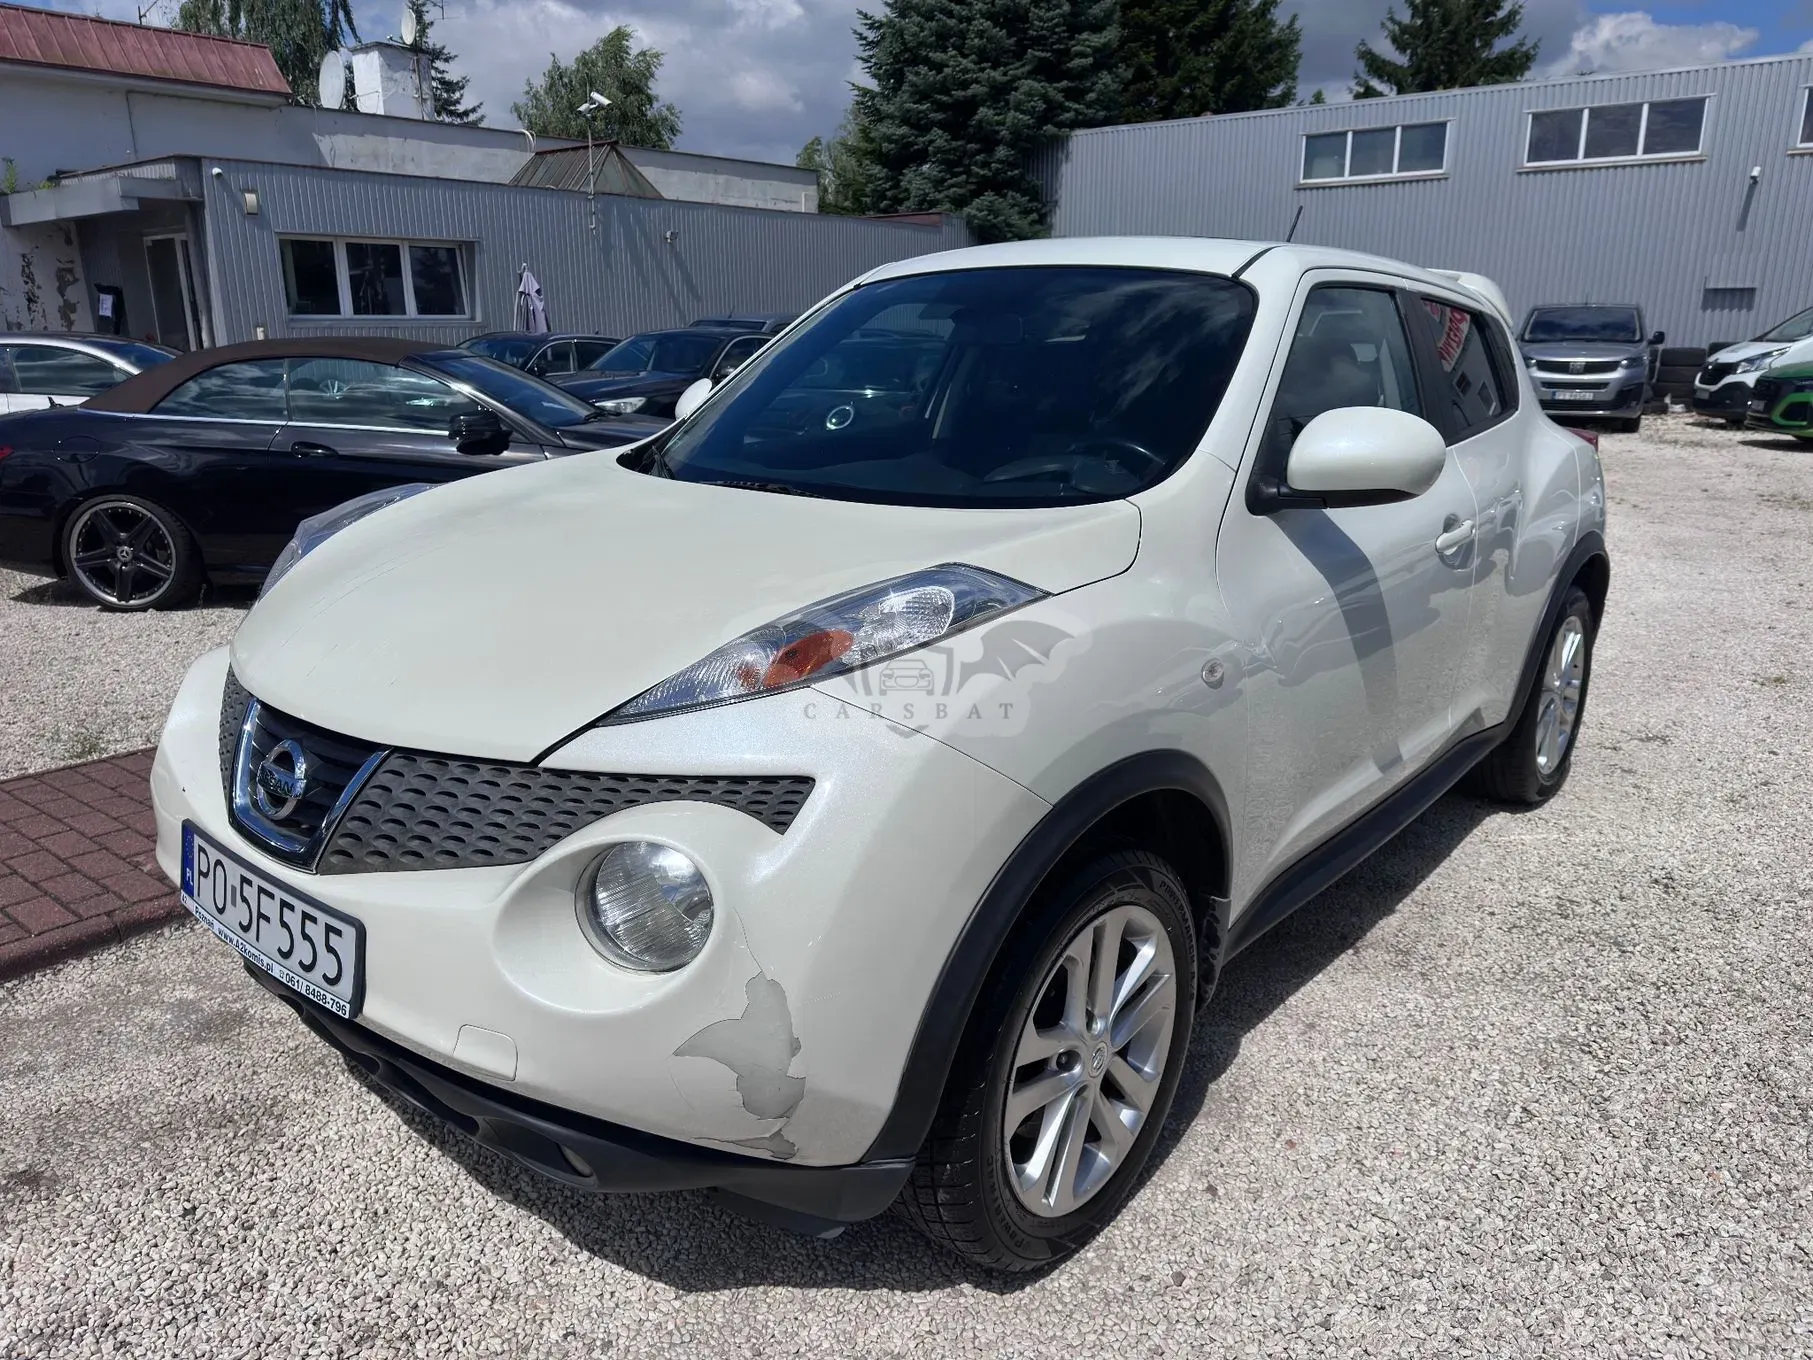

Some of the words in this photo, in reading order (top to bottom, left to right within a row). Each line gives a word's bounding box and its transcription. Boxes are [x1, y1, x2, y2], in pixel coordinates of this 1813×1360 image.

[186, 867, 194, 886] PL
[197, 843, 227, 915] PO
[238, 873, 343, 986] 5F555
[218, 926, 274, 973] www.A2komis.pl
